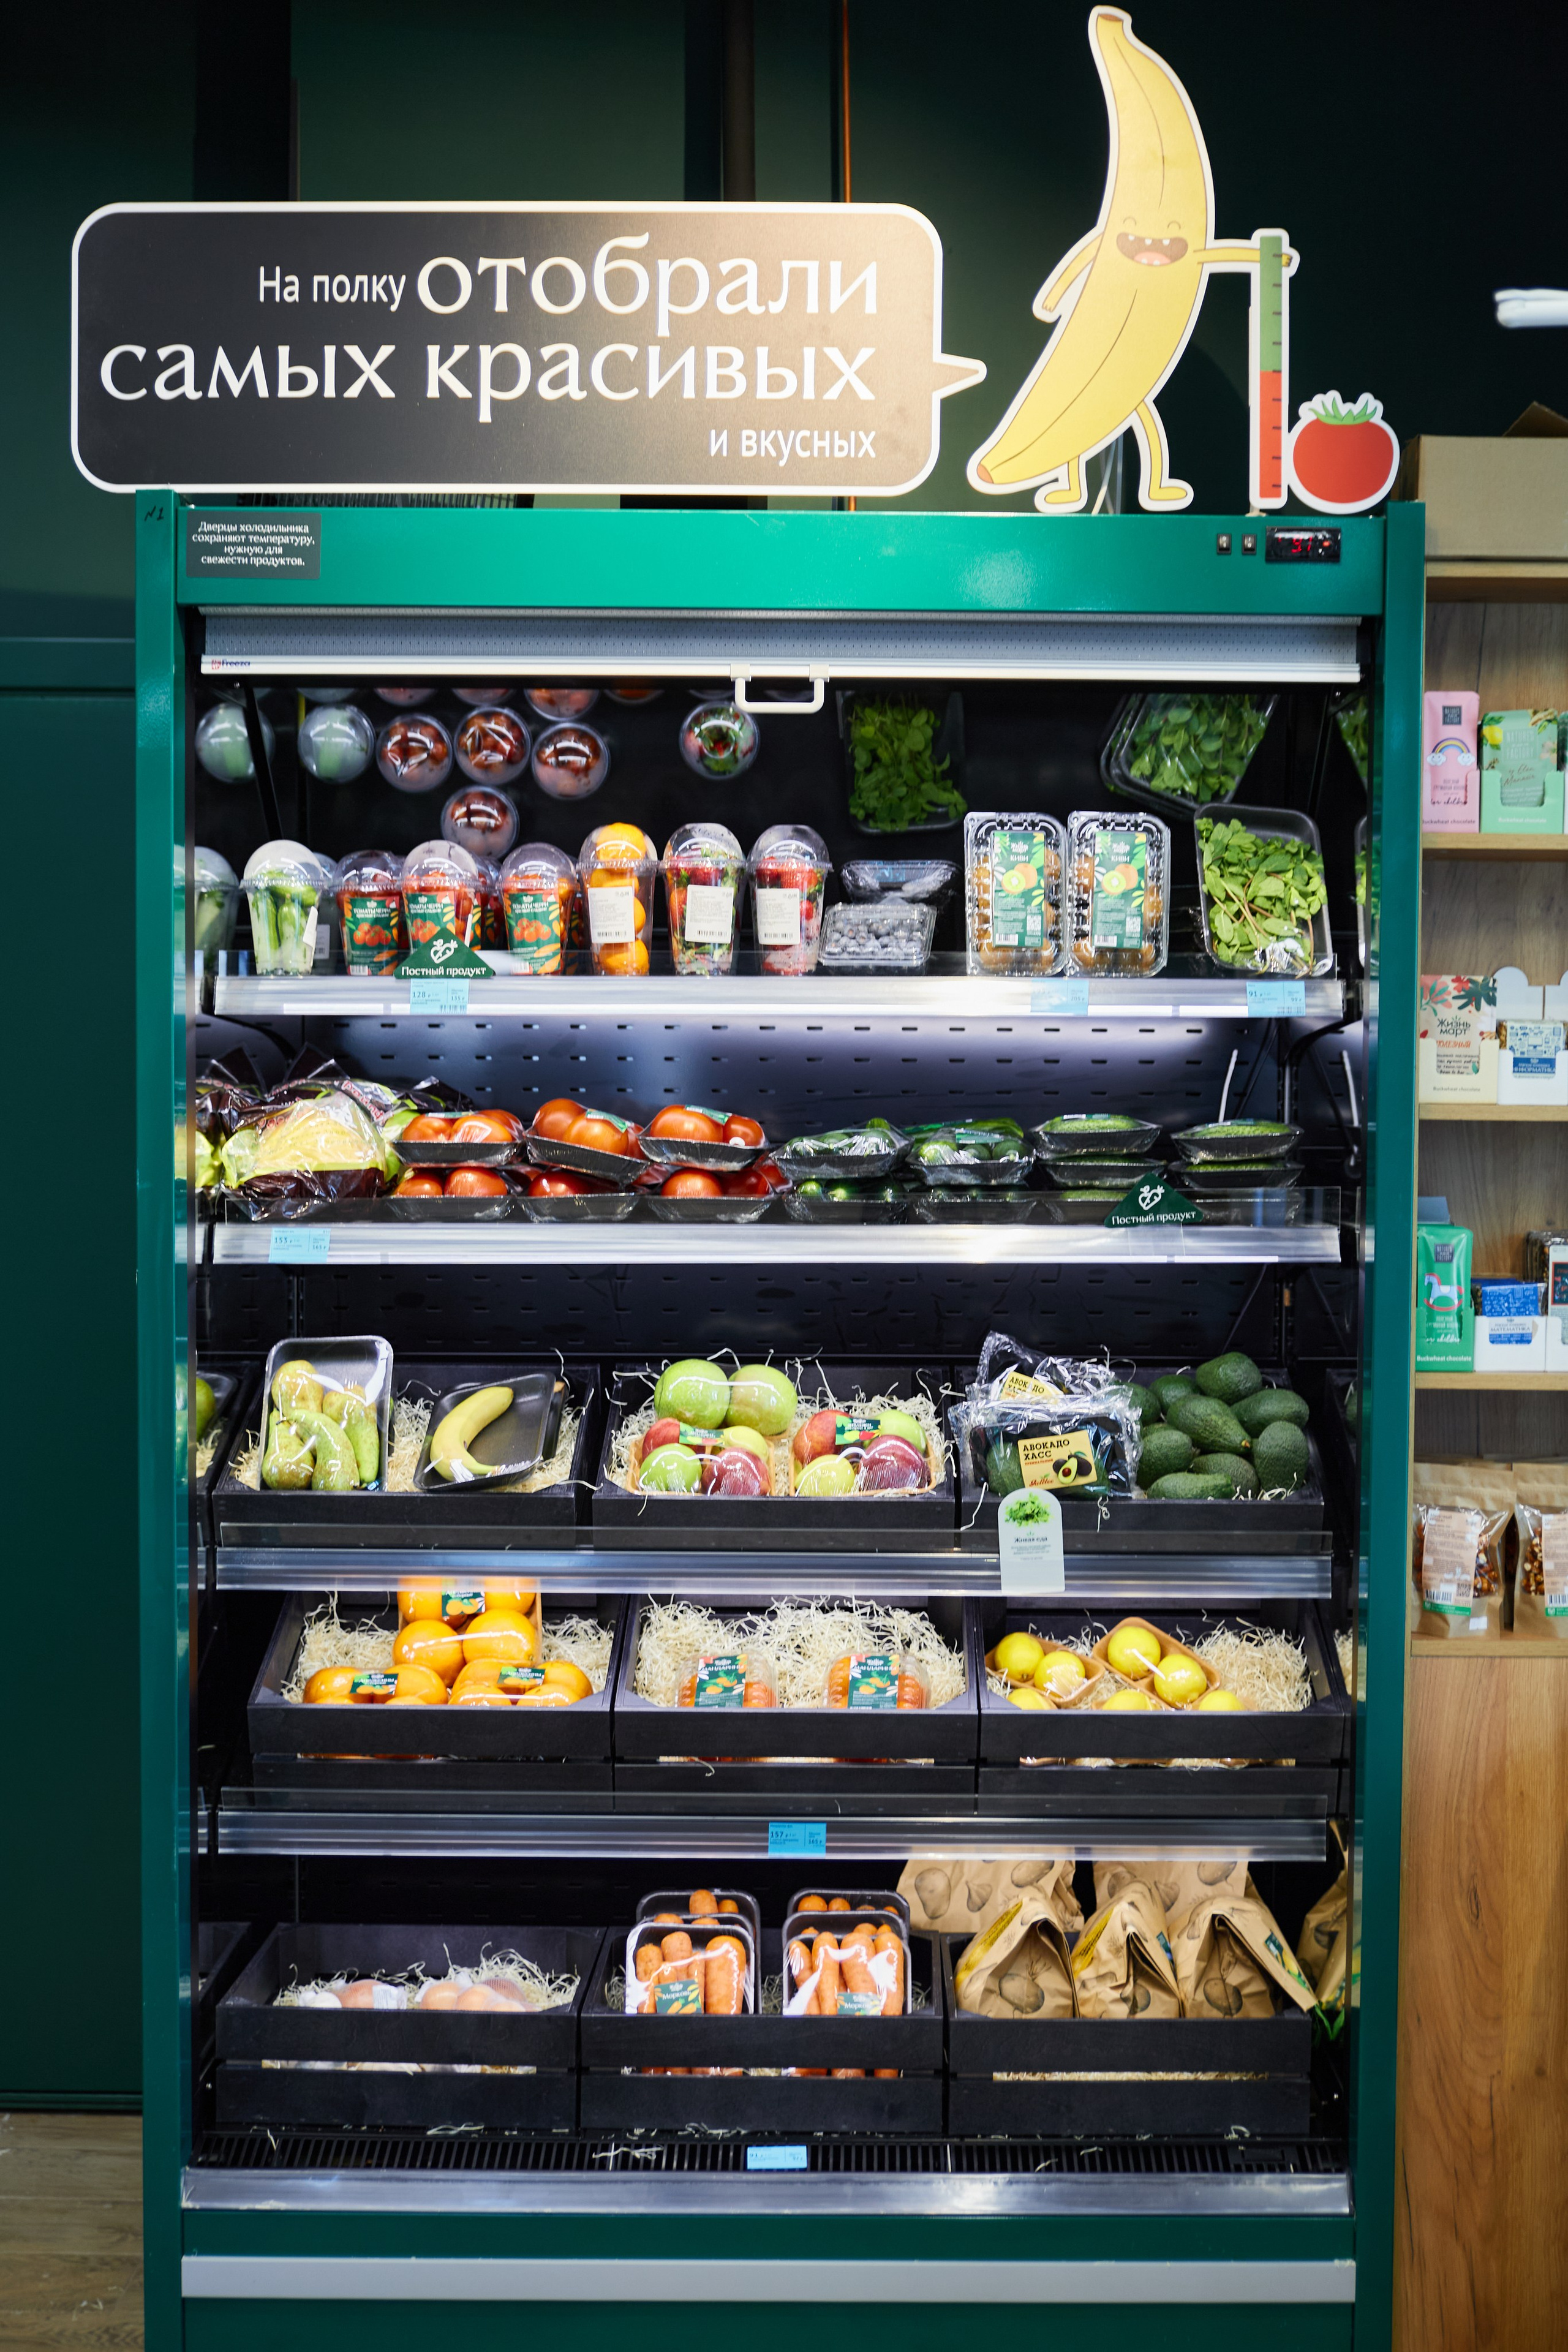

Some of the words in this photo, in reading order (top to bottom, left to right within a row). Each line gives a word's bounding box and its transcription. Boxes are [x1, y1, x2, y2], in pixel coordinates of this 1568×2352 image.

[260, 266, 299, 303] На
[313, 274, 405, 312] полку
[417, 232, 877, 337] отобрали
[100, 342, 396, 401] самых
[426, 342, 876, 423] красивых
[709, 429, 728, 458] и
[741, 429, 876, 467] вкусных
[198, 521, 238, 533] Дверцы
[239, 522, 309, 533] холодильника
[192, 533, 246, 544] сохраняют
[247, 535, 315, 546] температуру,
[224, 546, 263, 556] нужную
[265, 546, 283, 555] для
[201, 555, 248, 565] свежести
[250, 556, 305, 567] продуктов.
[401, 966, 445, 976] Постный
[446, 967, 486, 978] продукт
[1437, 1017, 1471, 1030] Жизнь
[1439, 1028, 1468, 1038] март
[1112, 1212, 1155, 1225] Постный
[1156, 1210, 1197, 1224] продукт
[1010, 1376, 1045, 1394] АВОКДО
[1023, 1439, 1070, 1452] АВОКАДО
[1023, 1450, 1052, 1461] ХАСС
[662, 1991, 692, 2000] Морковь
[844, 2002, 872, 2010] Морко
